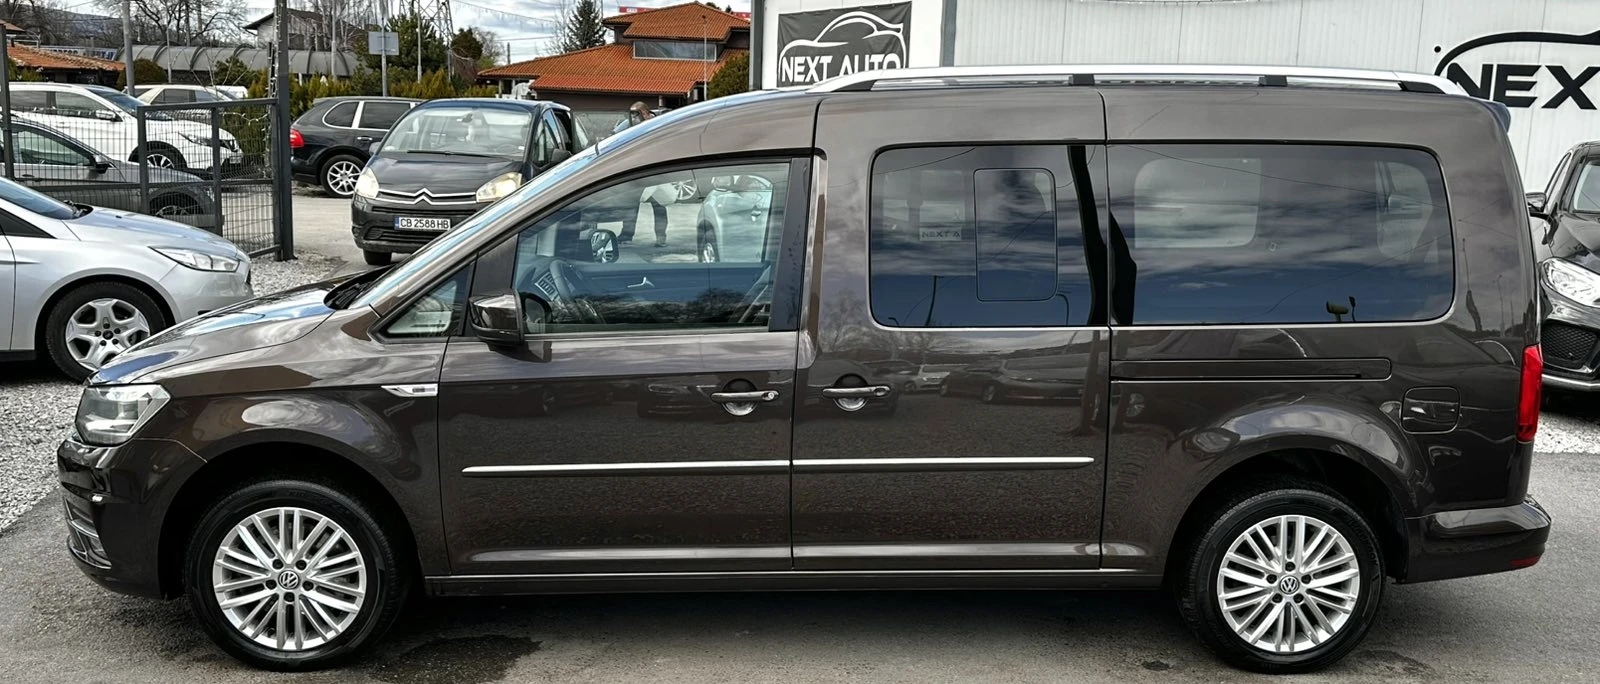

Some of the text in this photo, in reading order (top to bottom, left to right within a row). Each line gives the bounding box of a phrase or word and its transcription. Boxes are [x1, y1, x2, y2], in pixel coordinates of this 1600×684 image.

[781, 53, 901, 82] NEXT AUTO
[1447, 62, 1600, 110] NEX
[400, 218, 449, 229] CB 2588 HB
